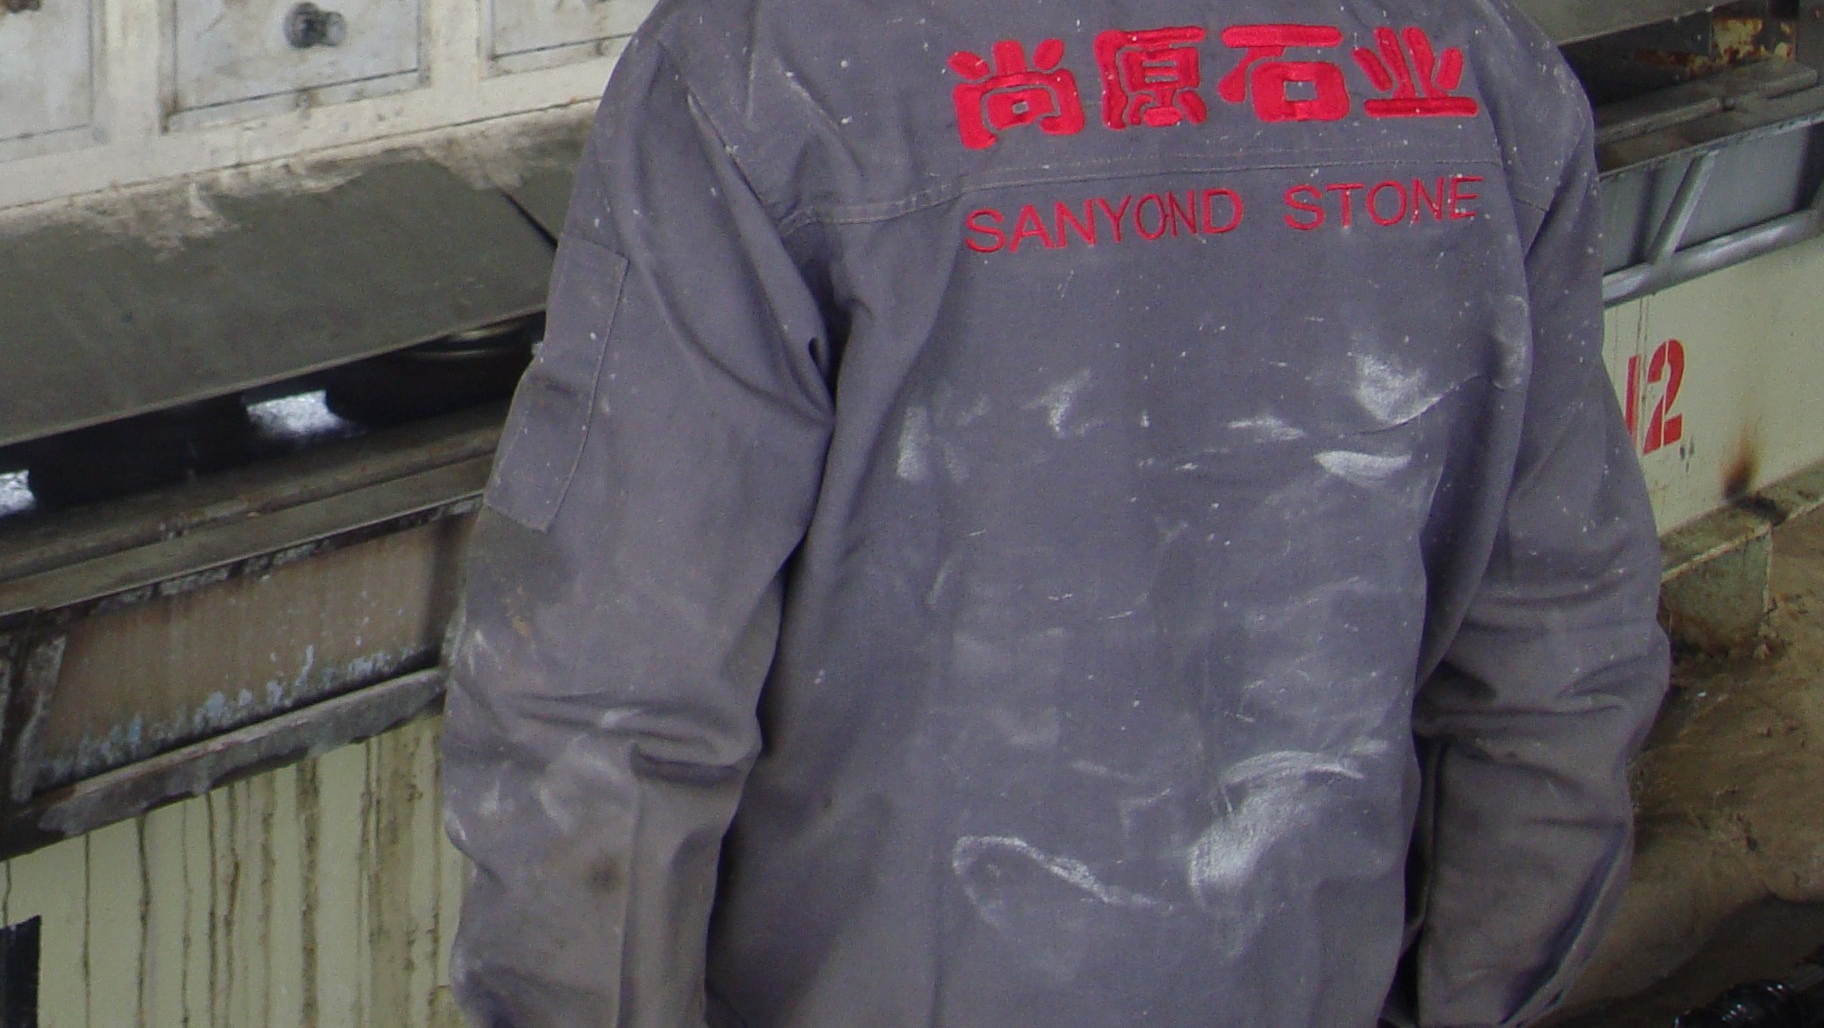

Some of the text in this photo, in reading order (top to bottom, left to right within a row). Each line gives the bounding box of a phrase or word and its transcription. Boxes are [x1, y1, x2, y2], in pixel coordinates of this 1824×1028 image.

[964, 175, 1485, 255] SANYOND STONE
[1624, 338, 1686, 456] 12
